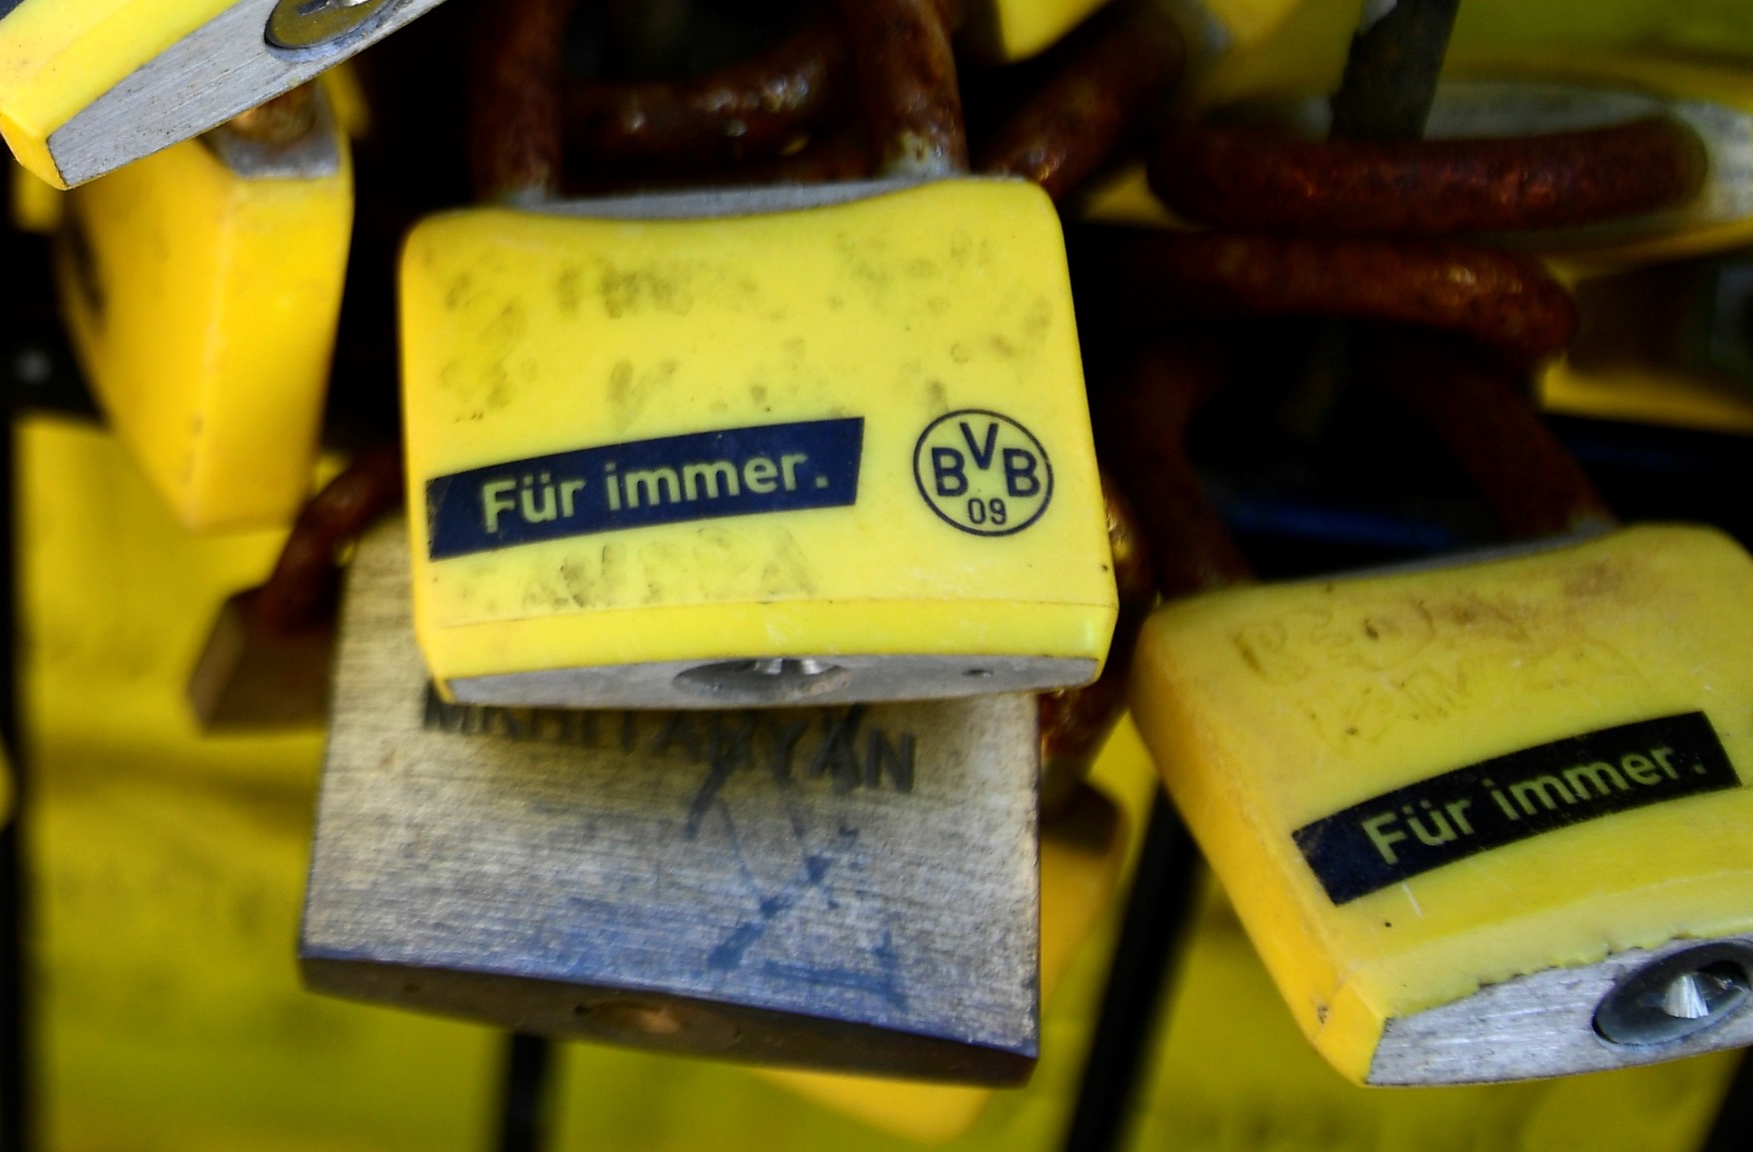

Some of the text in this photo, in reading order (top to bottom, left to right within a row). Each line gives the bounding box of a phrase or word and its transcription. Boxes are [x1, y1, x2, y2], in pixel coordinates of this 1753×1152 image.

[481, 450, 830, 533] Für immer.
[930, 422, 1042, 499] BVB
[966, 496, 1008, 527] 09
[1361, 745, 1708, 866] Für immer.
